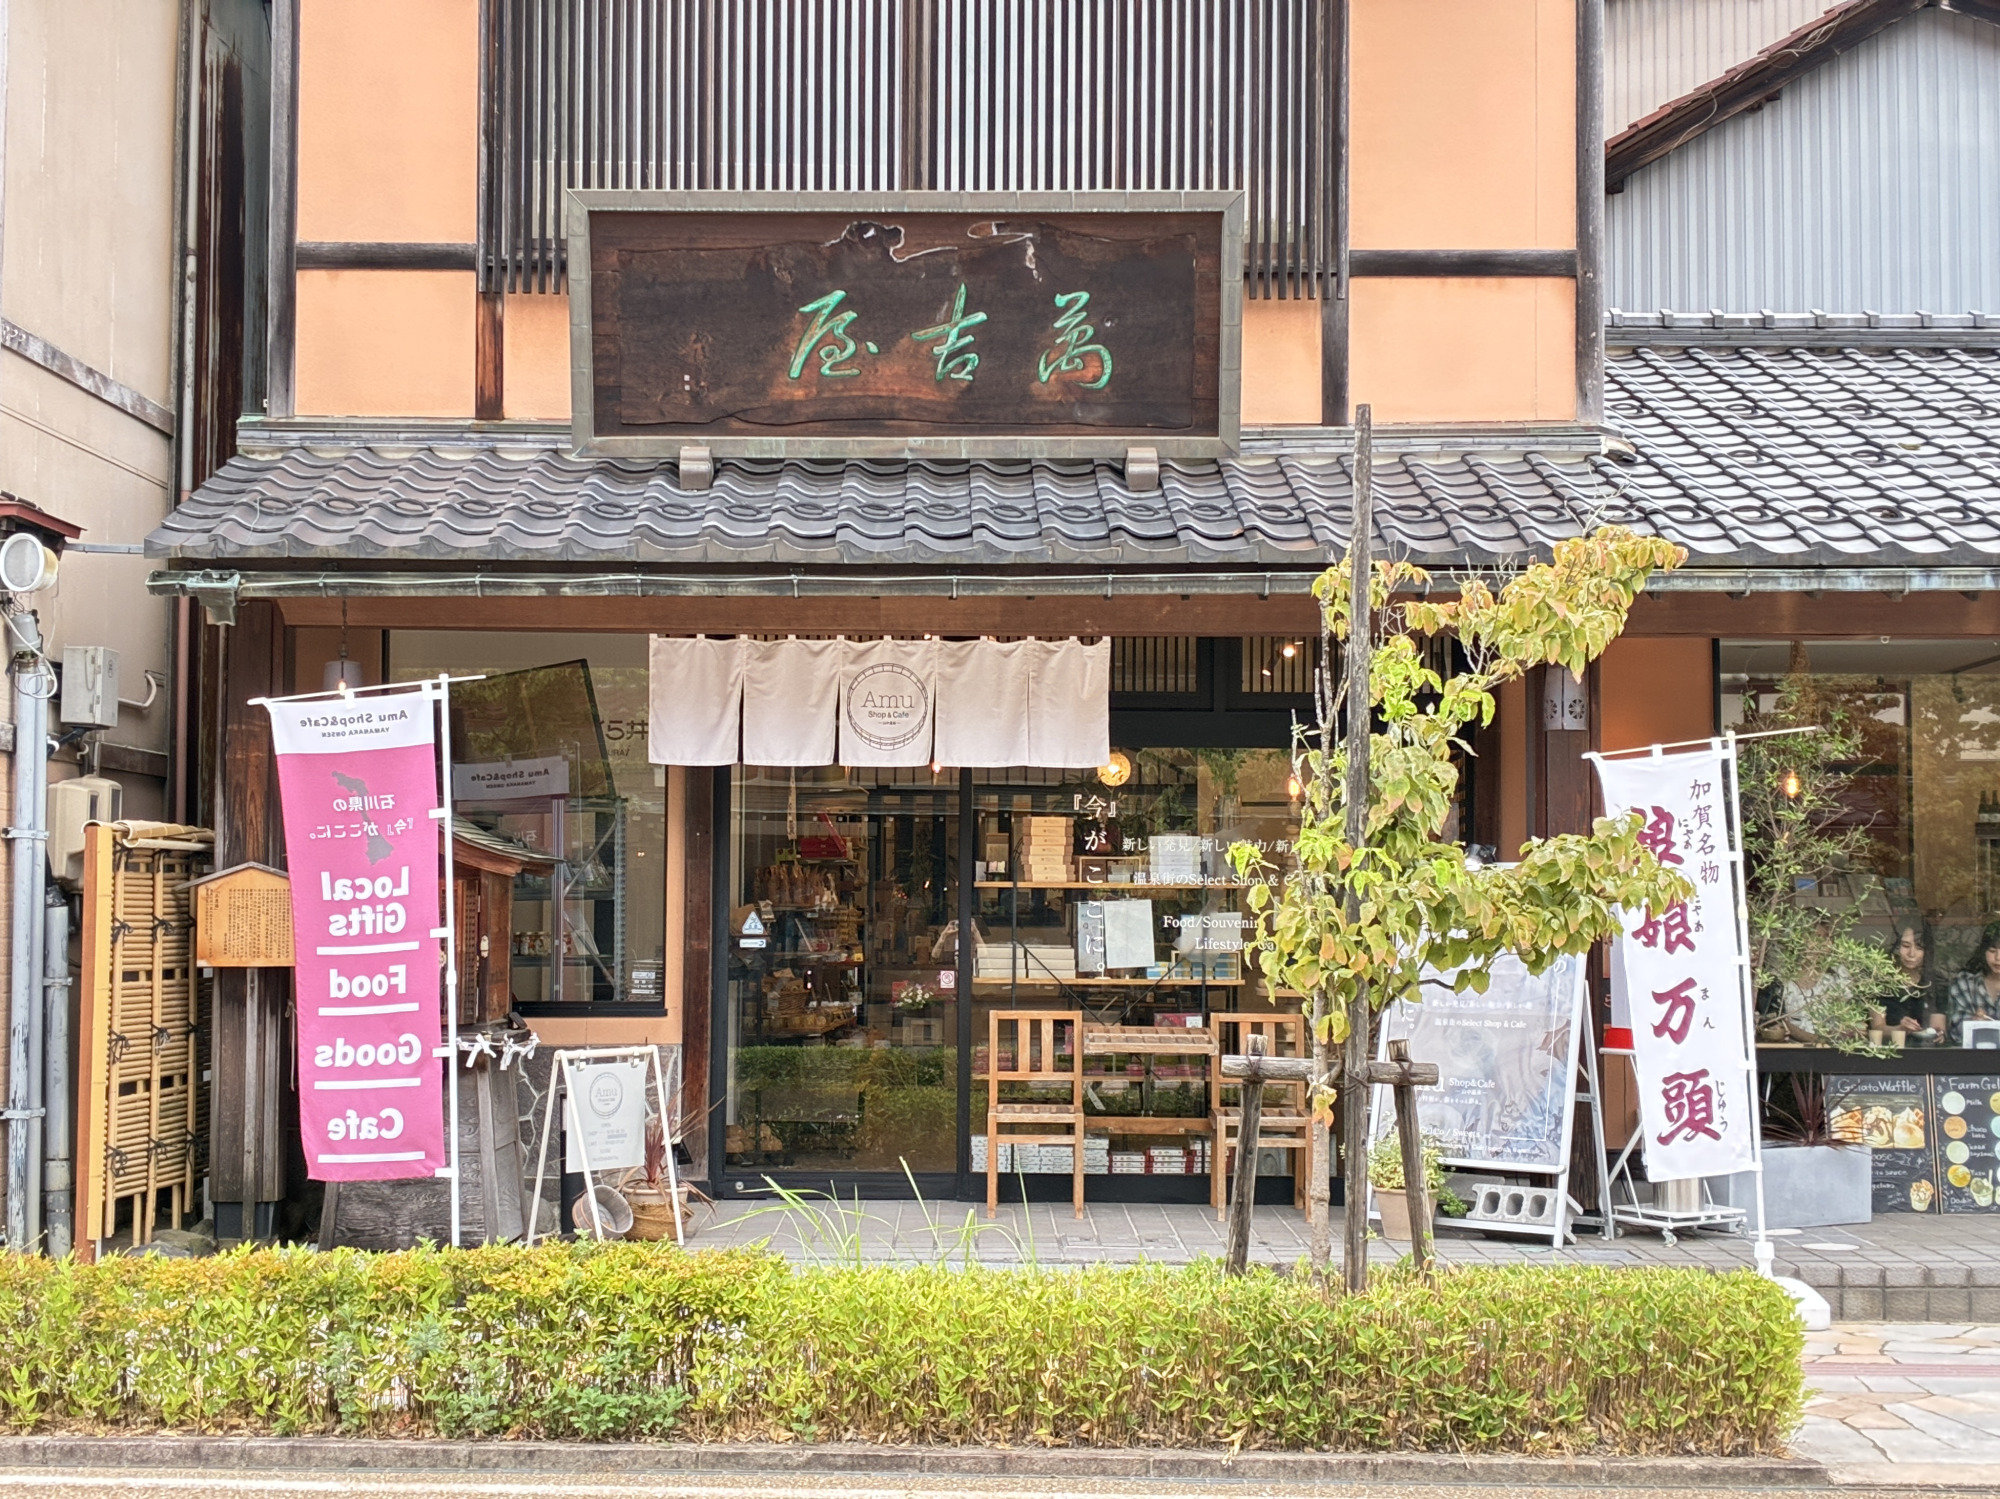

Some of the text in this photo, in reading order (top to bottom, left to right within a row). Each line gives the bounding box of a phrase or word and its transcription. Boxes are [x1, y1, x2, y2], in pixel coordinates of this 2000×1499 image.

[860, 690, 915, 709] Amu
[868, 710, 886, 720] Shop
[893, 710, 910, 719] Cafe
[1689, 778, 1720, 886] 加賀名物
[1269, 874, 1280, 888] &
[1449, 1077, 1496, 1090] Shop&Cafe
[1878, 1079, 1917, 1093] Waffle
[1948, 1077, 1980, 1091] Farm
